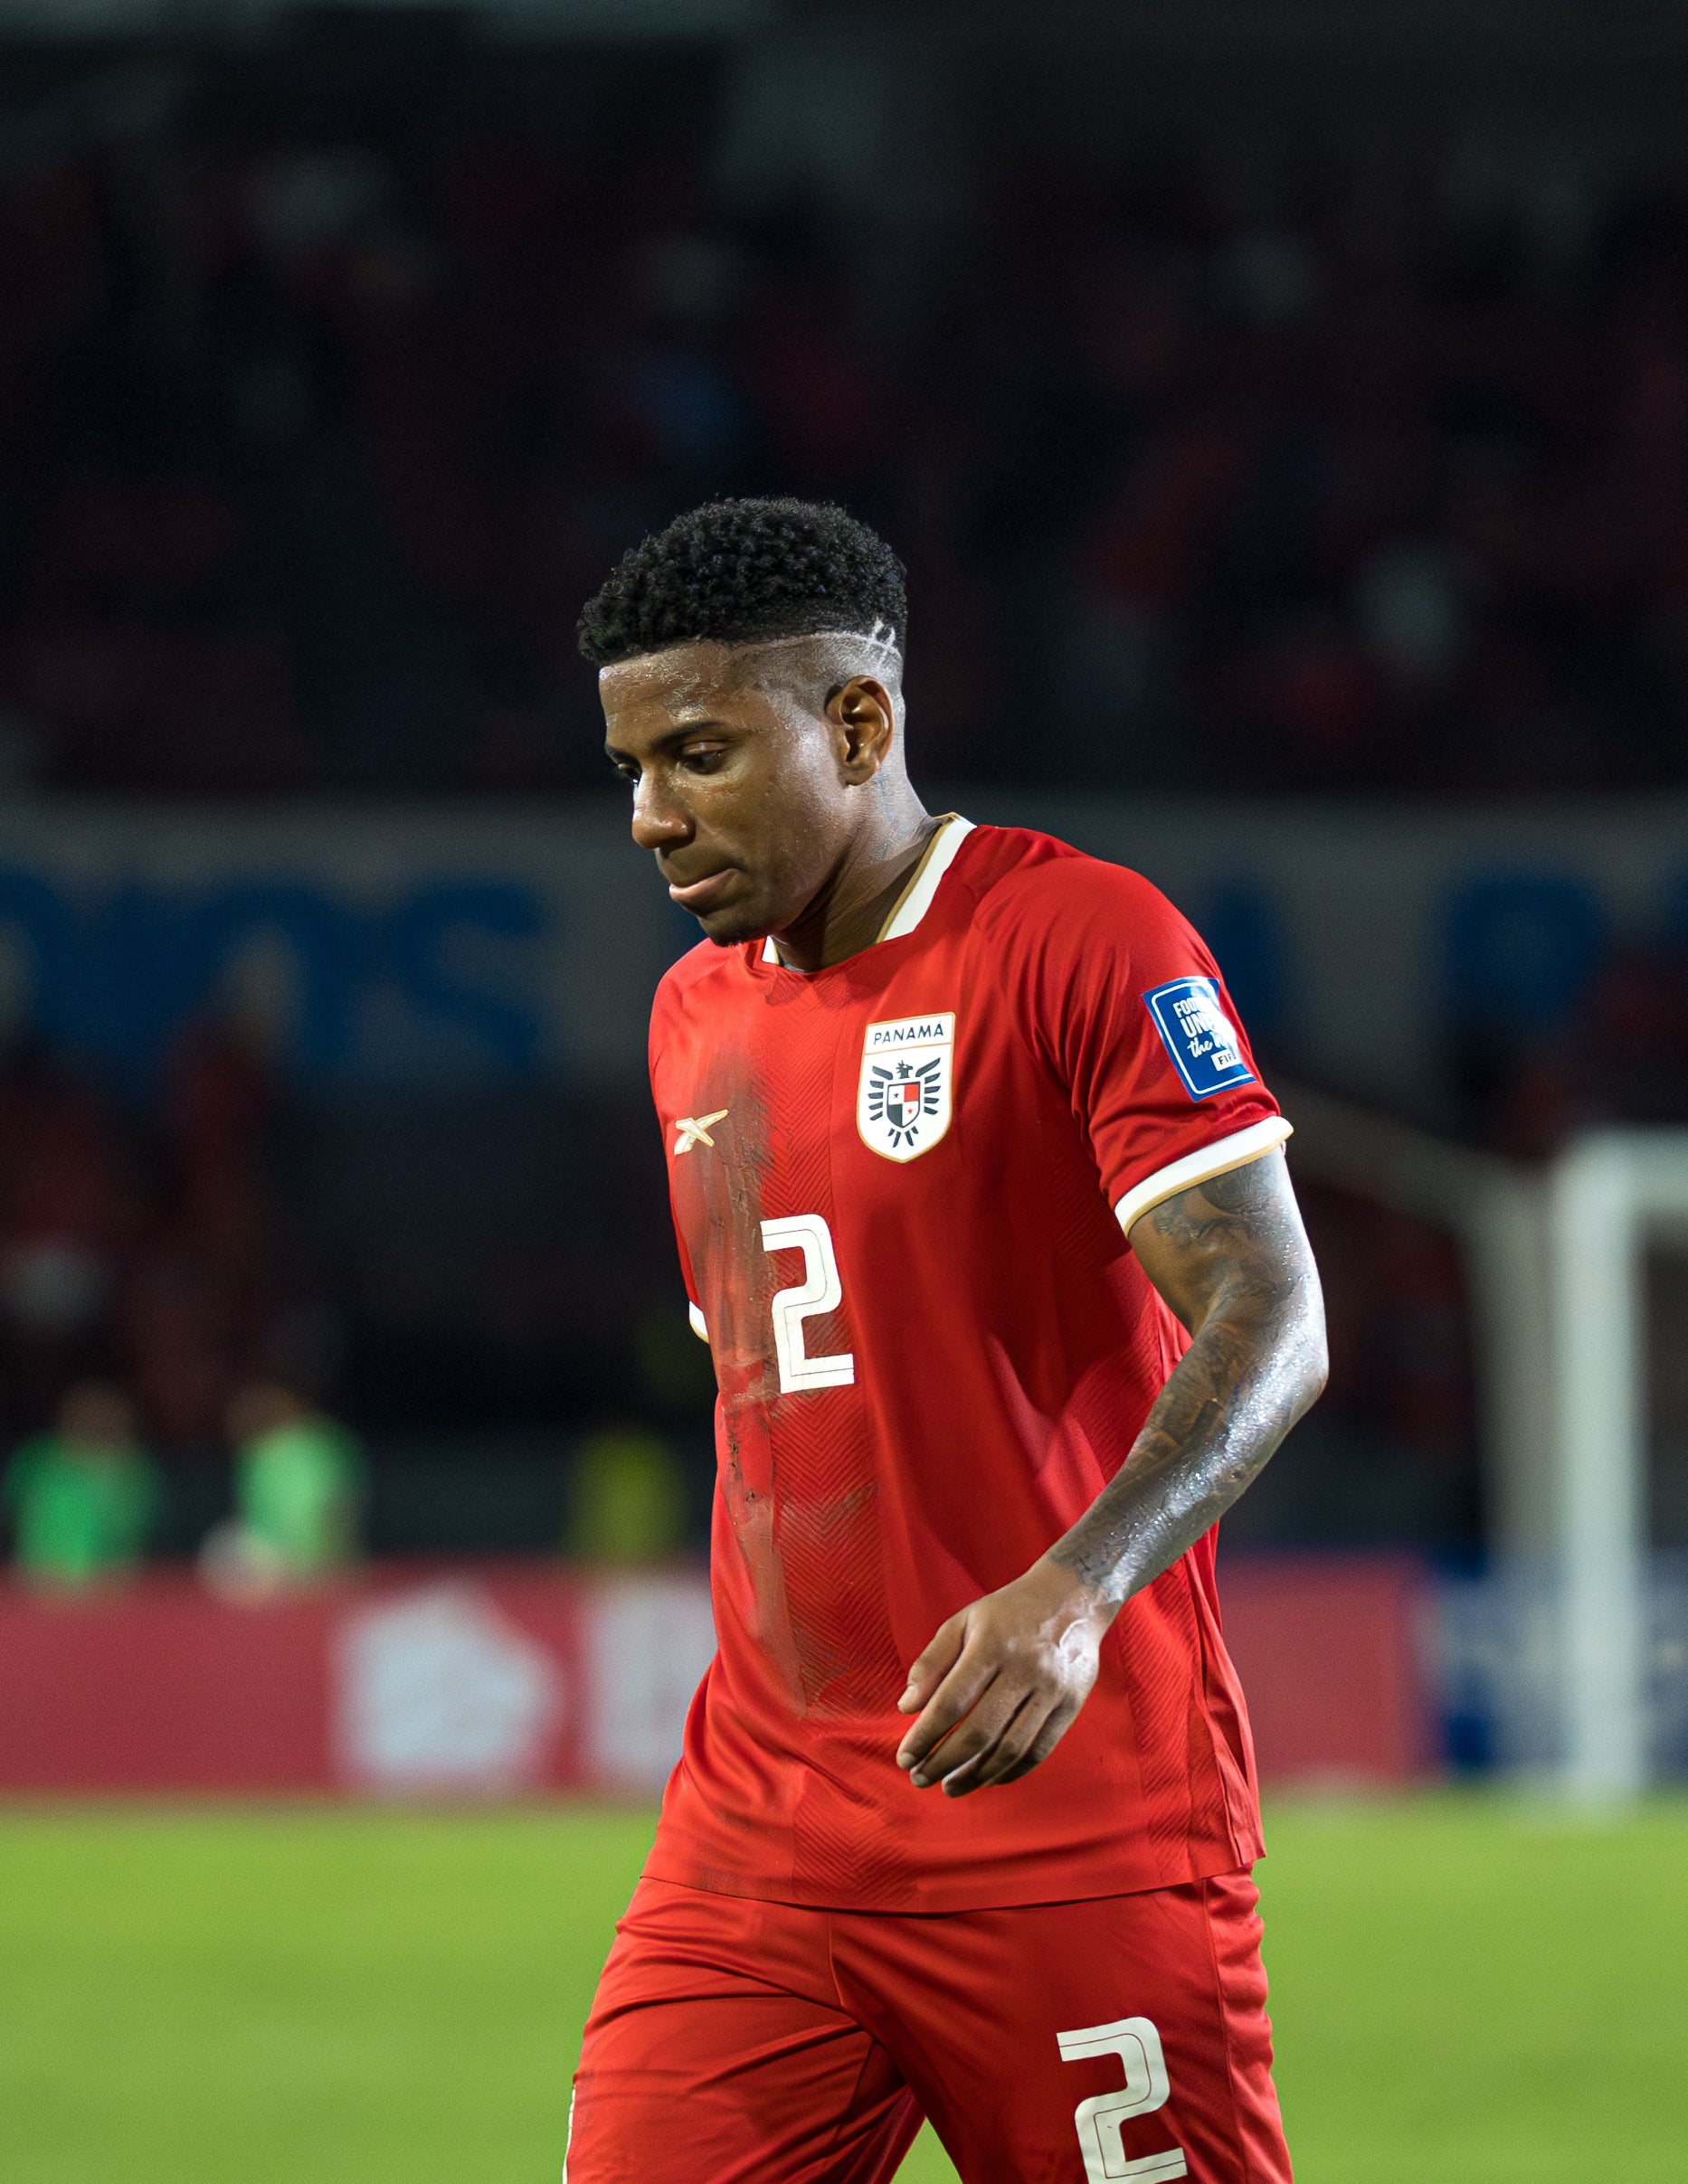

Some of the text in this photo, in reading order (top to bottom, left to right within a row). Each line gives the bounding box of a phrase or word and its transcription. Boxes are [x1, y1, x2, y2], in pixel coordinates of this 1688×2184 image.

[1187, 1037, 1212, 1058] the
[760, 1214, 855, 1394] 2
[1057, 2017, 1188, 2184] 2
